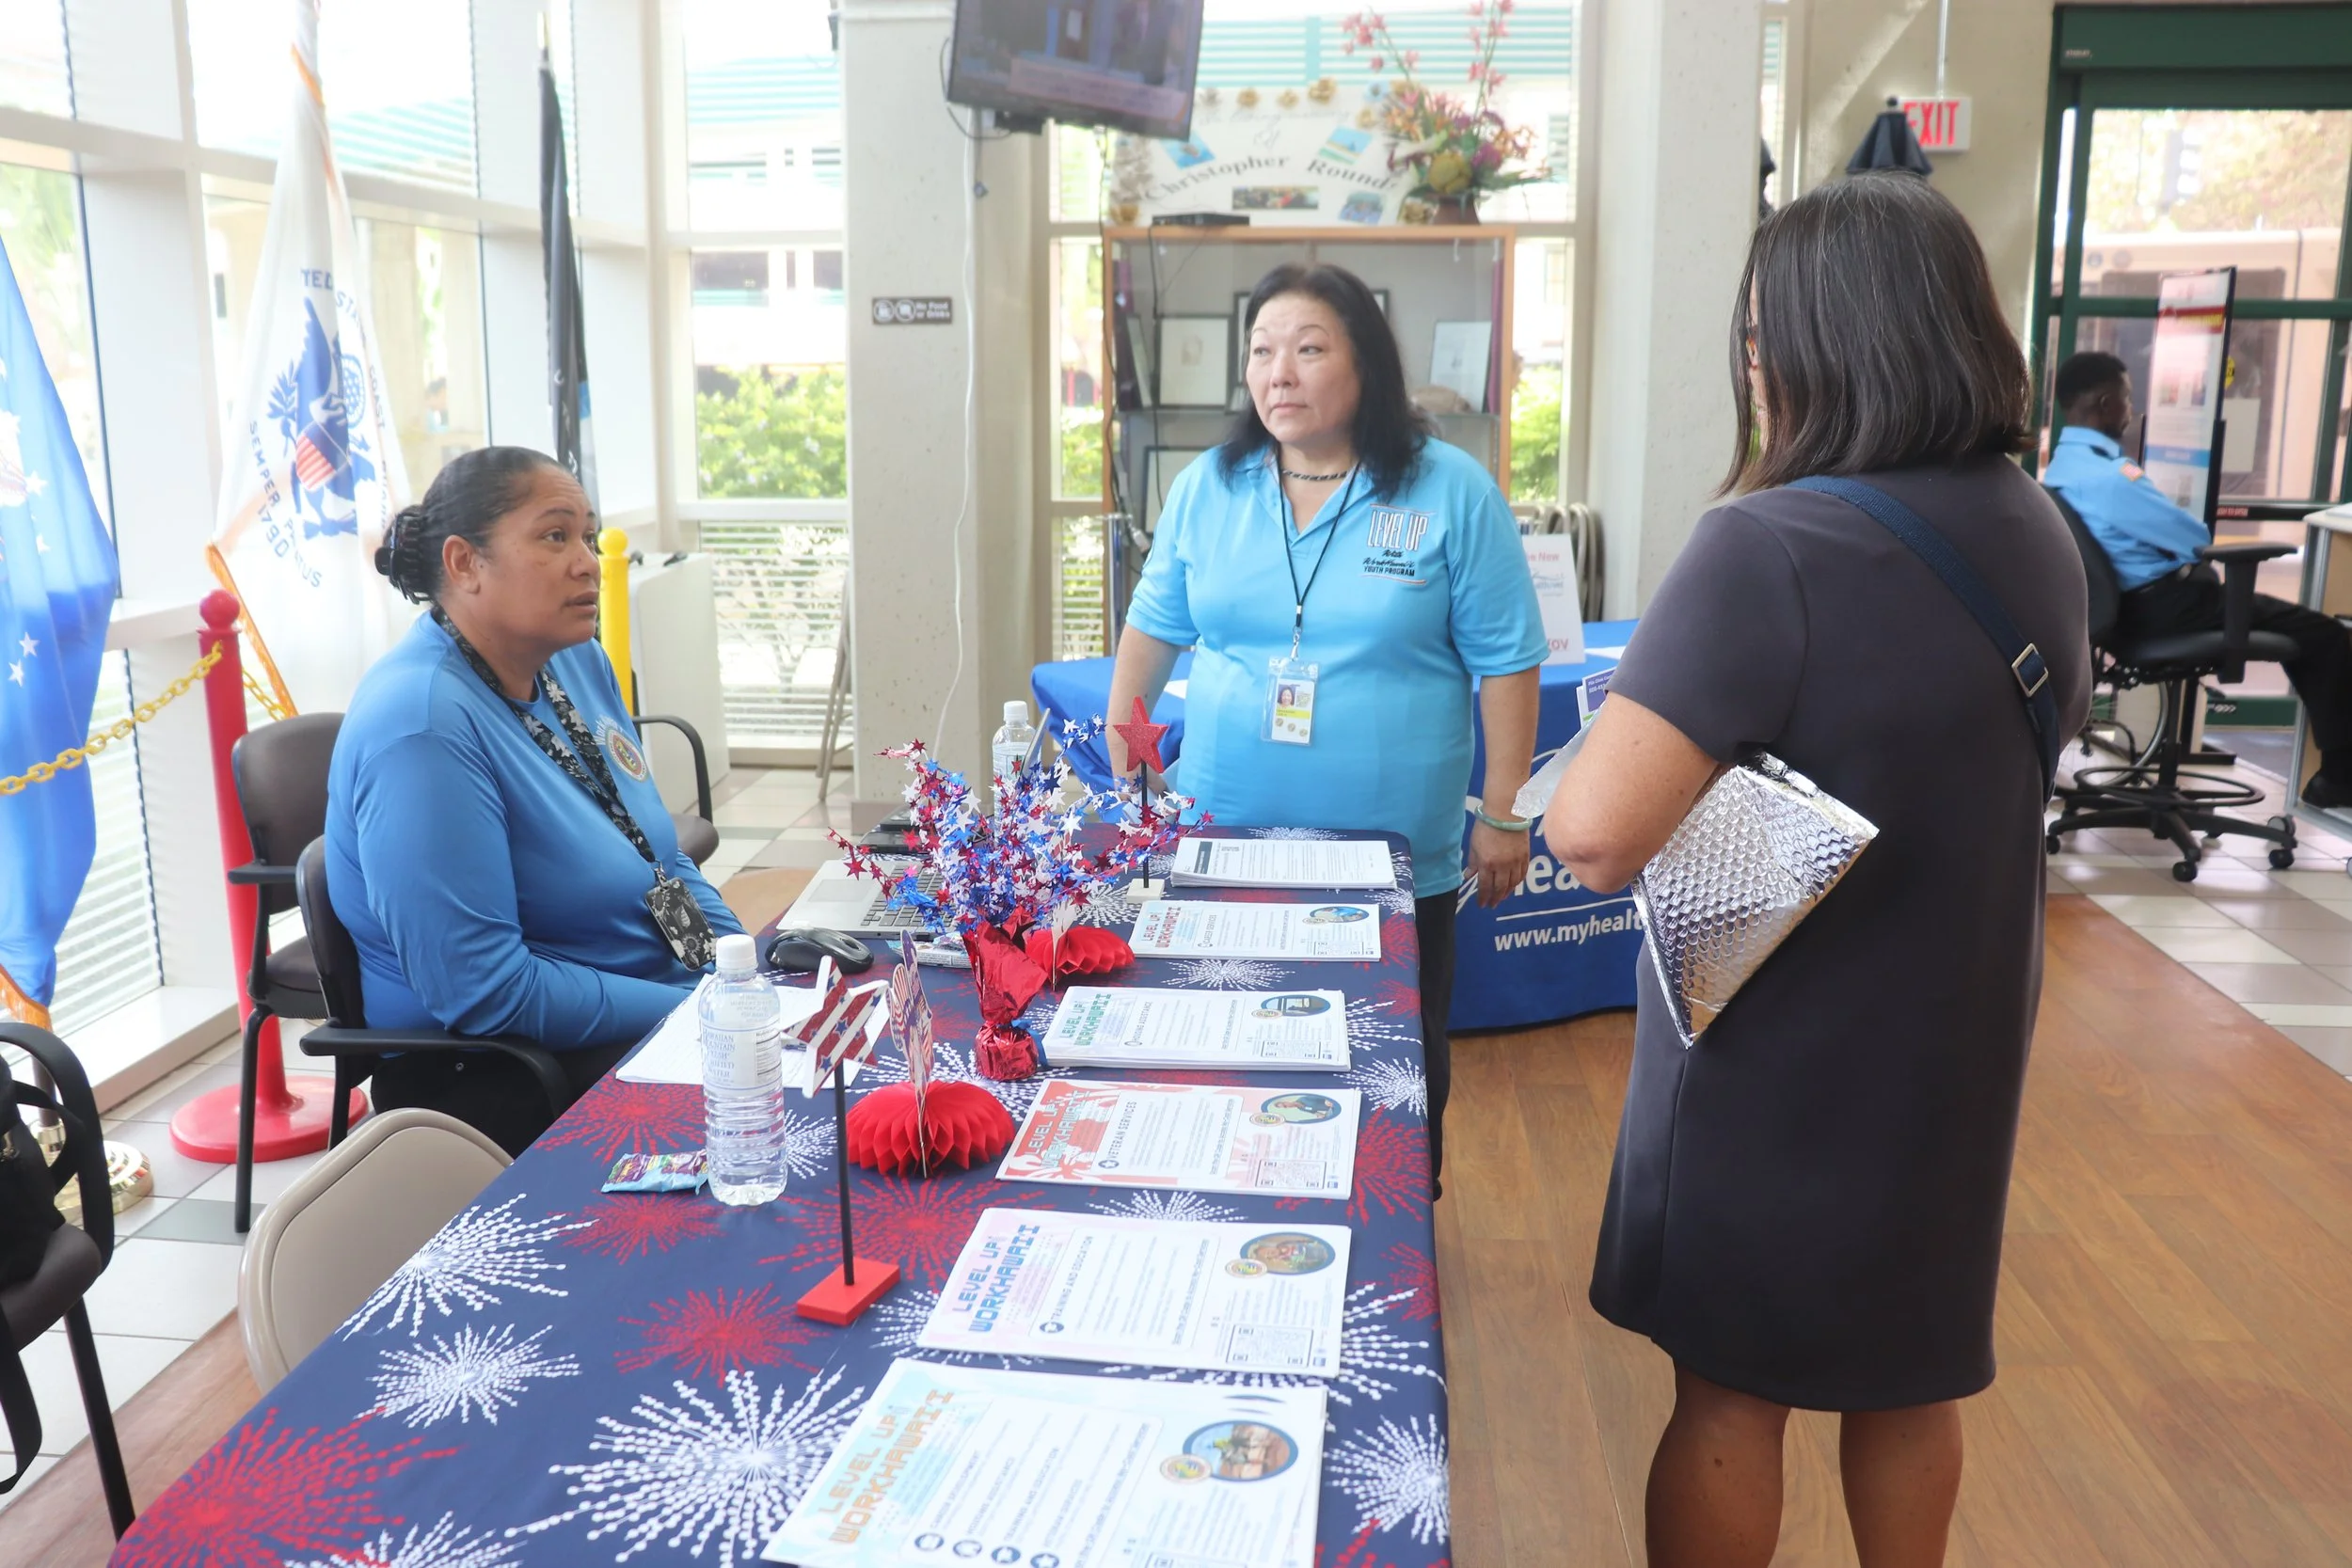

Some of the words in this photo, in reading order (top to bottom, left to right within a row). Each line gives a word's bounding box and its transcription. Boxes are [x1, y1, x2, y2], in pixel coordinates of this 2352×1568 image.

[1142, 154, 1290, 203] Christopher
[249, 420, 281, 509] SEMPER
[257, 504, 291, 558] 1790
[1367, 510, 1406, 549] LEVEL
[1405, 514, 1429, 551] UP
[1364, 566, 1384, 575] YOUTH
[1384, 567, 1415, 577] PROGRAM
[1494, 908, 1644, 952] www.myhealt
[1058, 1015, 1082, 1037] LEVEL
[1071, 1004, 1087, 1013] UP
[1024, 1120, 1054, 1154] LEVEL
[1041, 1103, 1061, 1117] UP
[1106, 1131, 1126, 1158] VETERAN
[1118, 1101, 1136, 1129] SERVICES
[1071, 1236, 1093, 1270] EDUCATION
[951, 1263, 993, 1311] LEVEL
[977, 1242, 1003, 1259] UP
[1064, 1272, 1079, 1286] AND
[1049, 1288, 1073, 1320] TRAINING
[816, 1446, 882, 1513] LEVEL
[868, 1414, 903, 1438] UP
